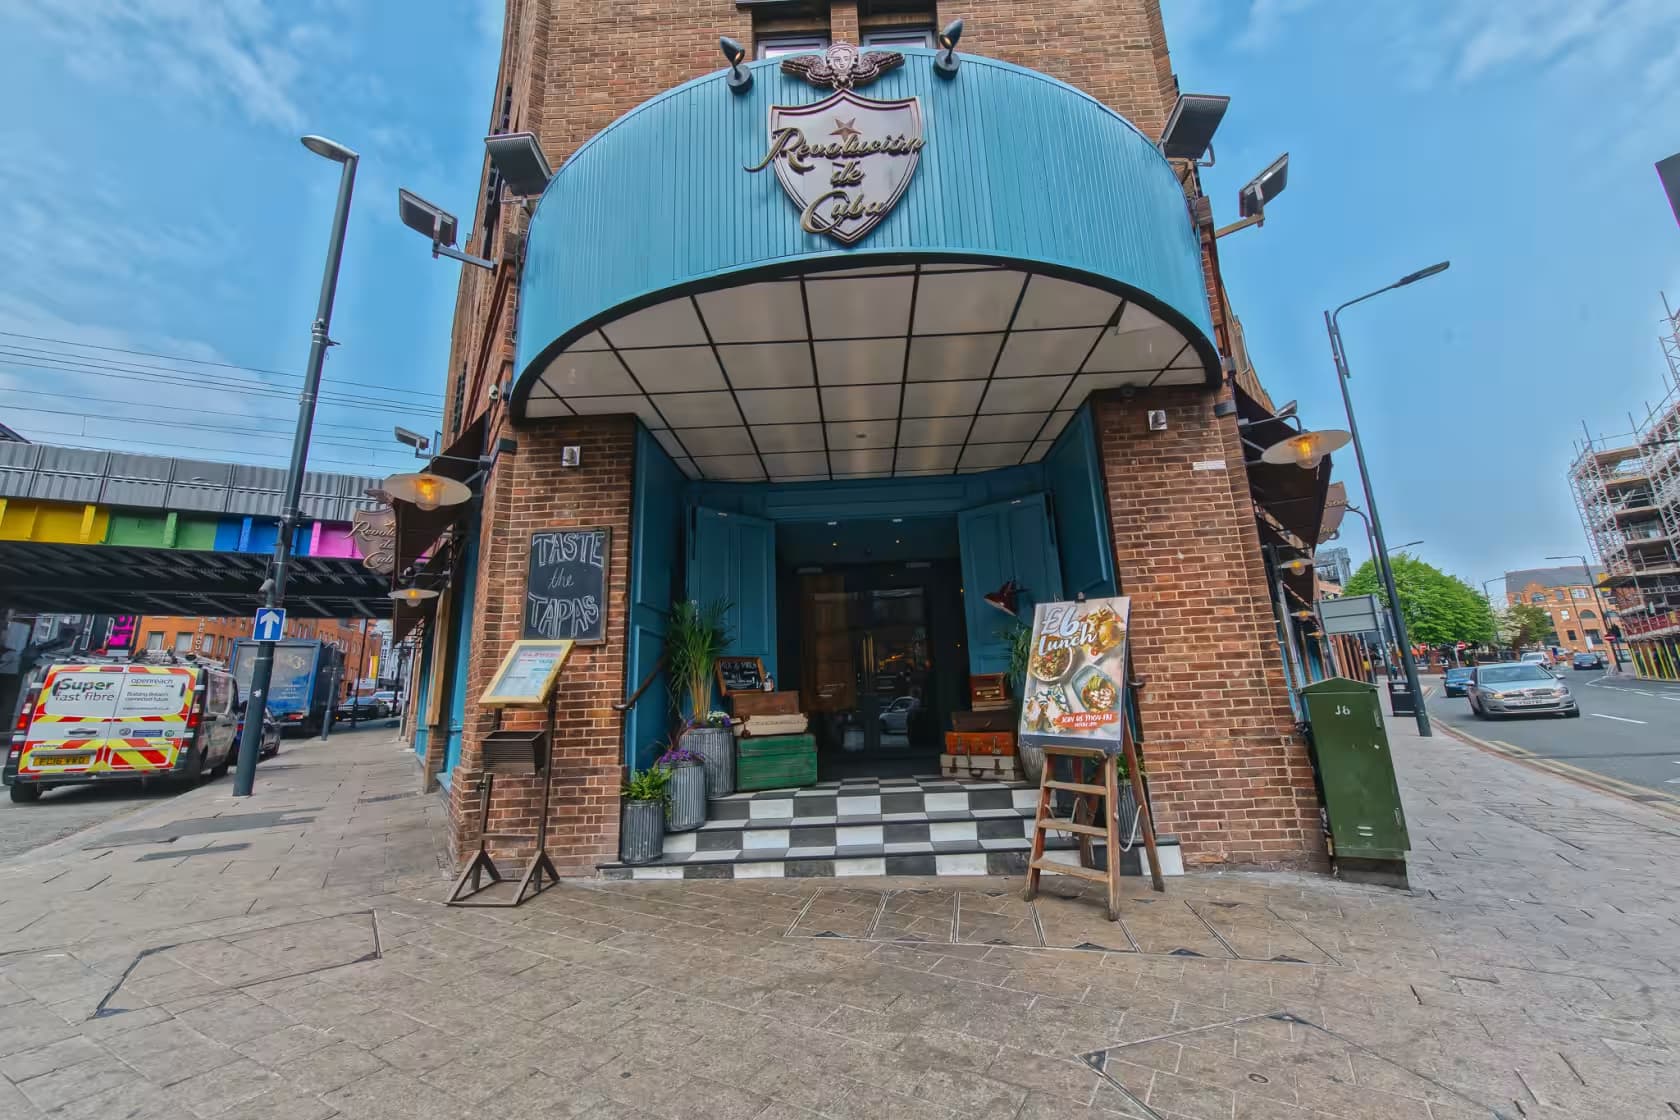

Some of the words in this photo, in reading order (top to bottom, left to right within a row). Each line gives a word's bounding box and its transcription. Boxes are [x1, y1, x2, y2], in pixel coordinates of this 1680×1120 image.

[743, 127, 926, 174] Revolución
[830, 161, 864, 187] de
[800, 190, 887, 233] Cuba
[532, 531, 605, 567] TASTE
[547, 567, 575, 590] the
[528, 591, 599, 640] TAPAS
[55, 692, 80, 701] fast
[85, 691, 115, 701] fibre
[58, 678, 115, 693] Super
